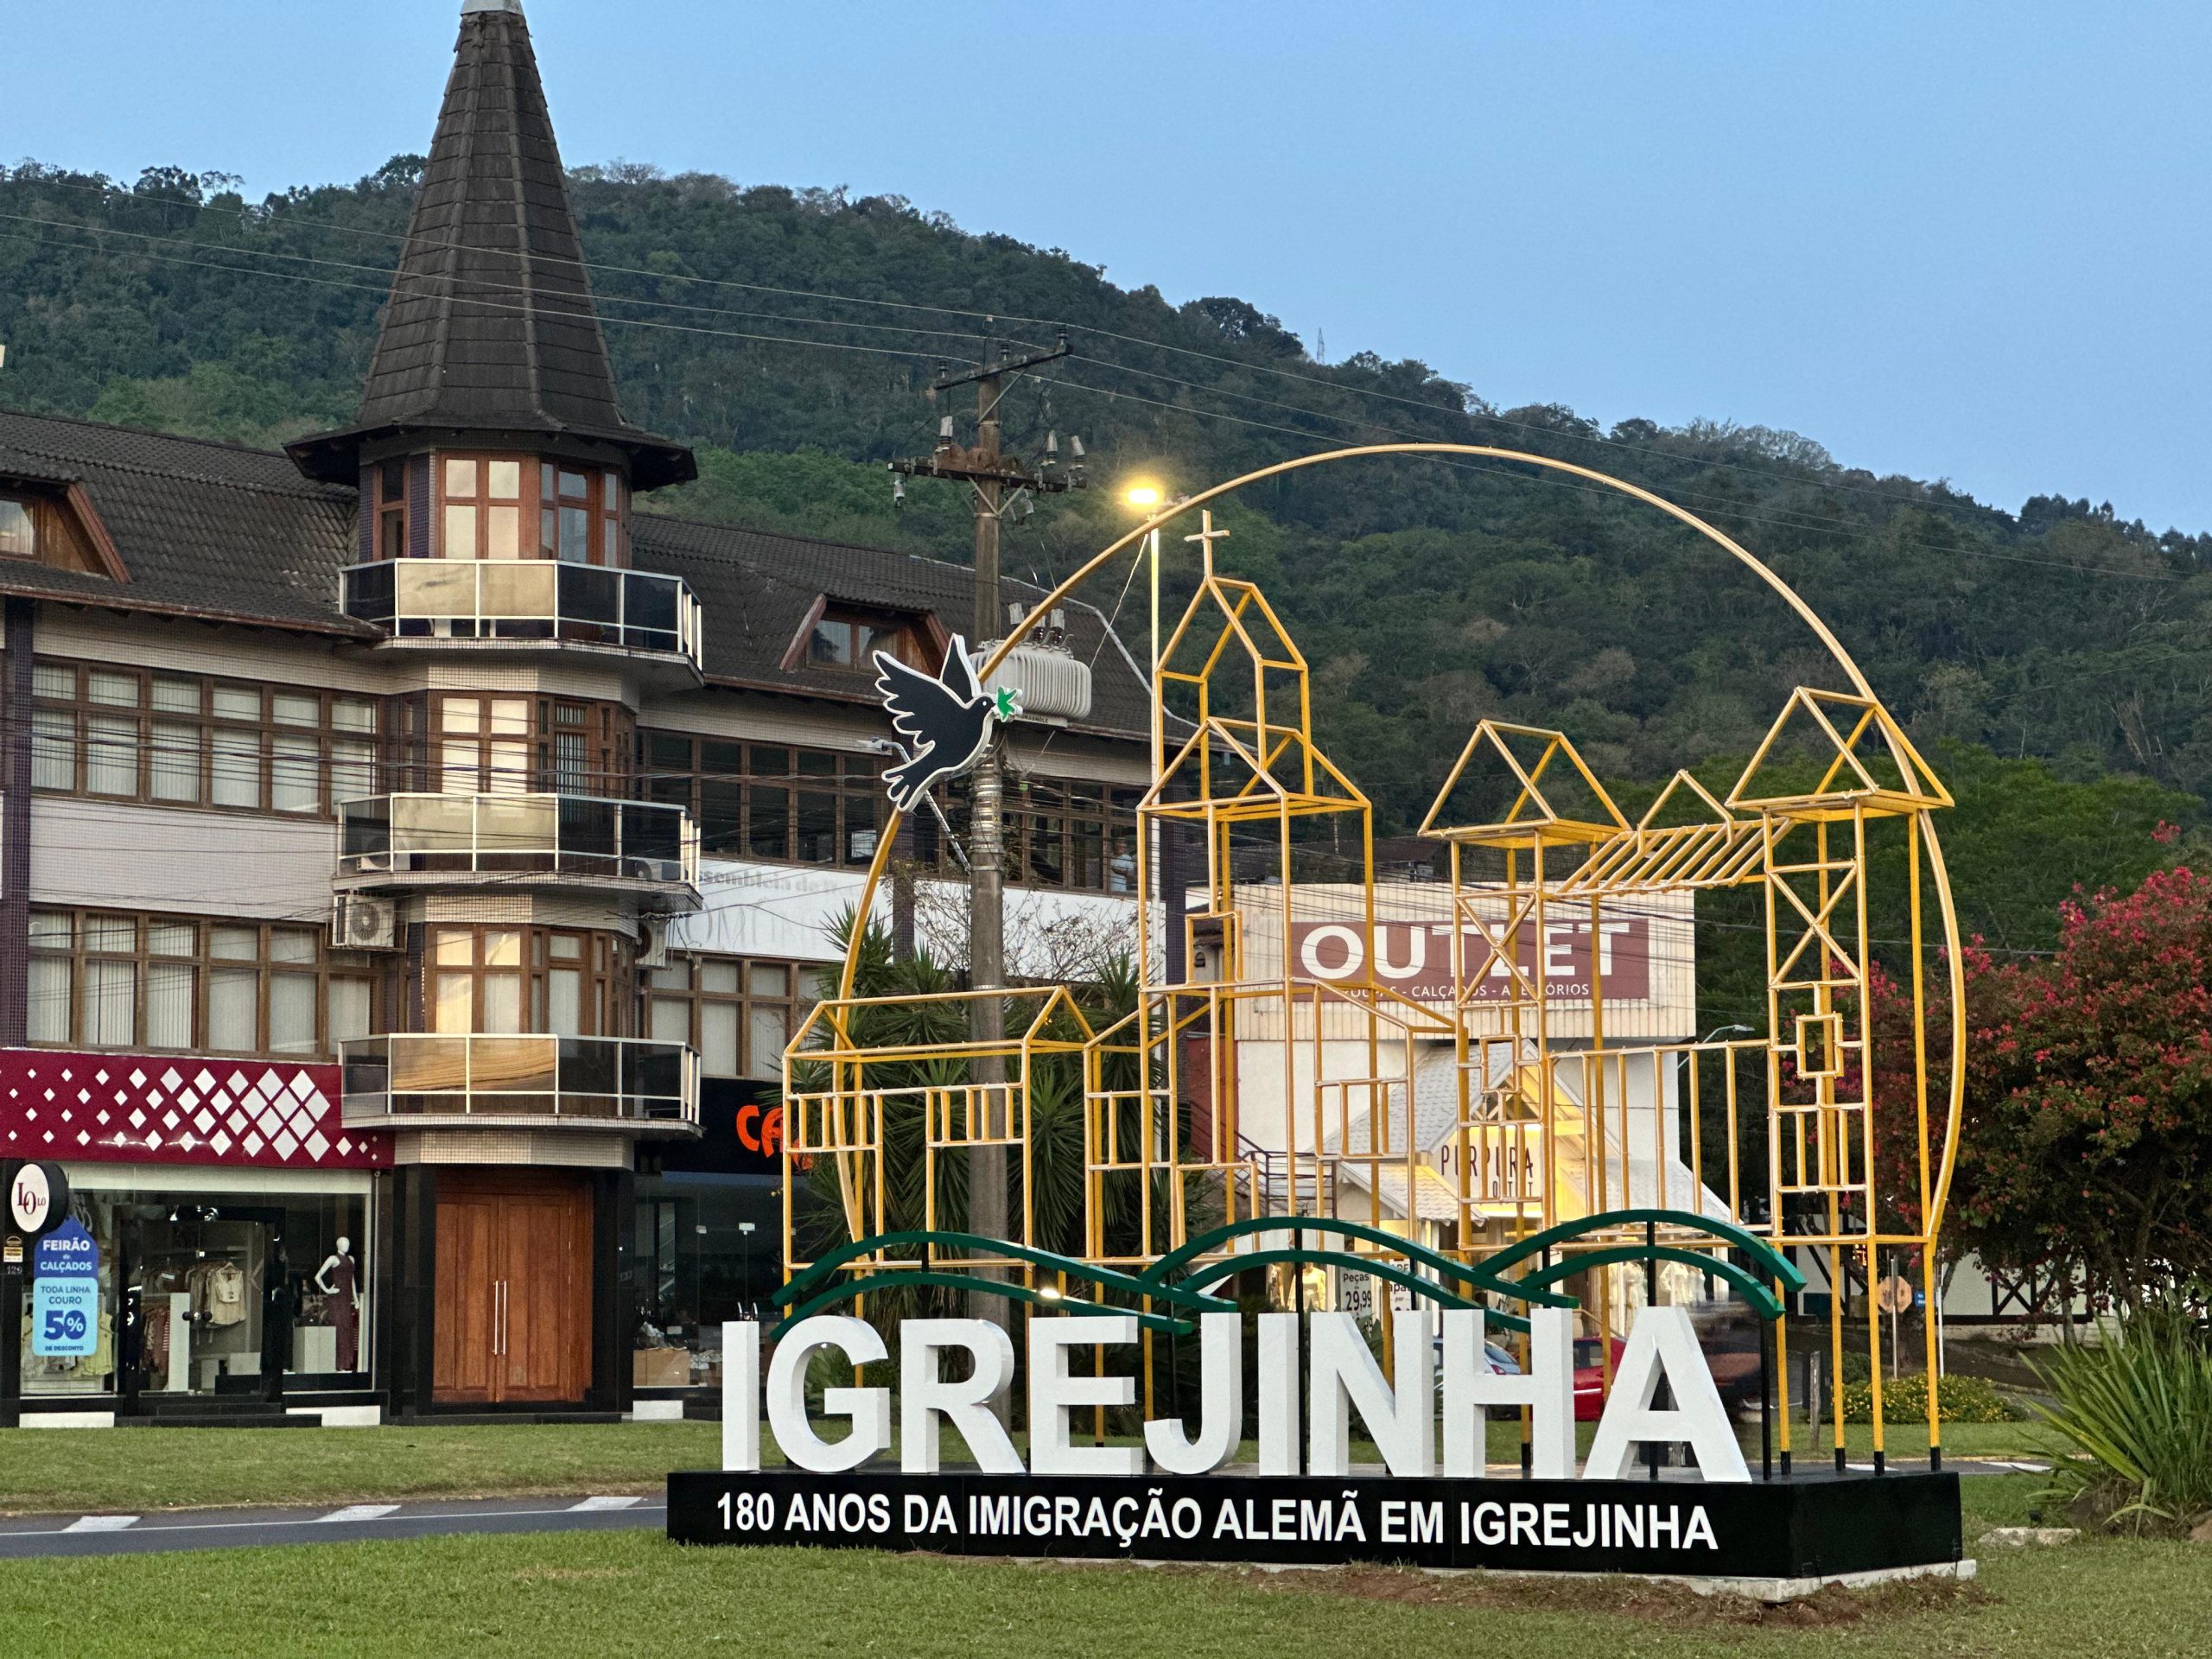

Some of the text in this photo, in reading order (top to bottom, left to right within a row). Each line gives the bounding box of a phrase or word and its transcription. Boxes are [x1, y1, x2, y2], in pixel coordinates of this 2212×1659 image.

[1300, 922, 1630, 979] OUTLET
[42, 1236, 91, 1251] FEIRÃO
[40, 1262, 92, 1274] CALÇADOS
[1343, 1273, 1370, 1285] Peças
[48, 1296, 82, 1305] COURO
[1345, 1290, 1372, 1312] 29,99
[721, 1306, 1752, 1484] IGREJINHA
[717, 1487, 1719, 1550] 180 ANOS DA IMIGRAÇÃO ALEMÃ EM IGREJINHA
